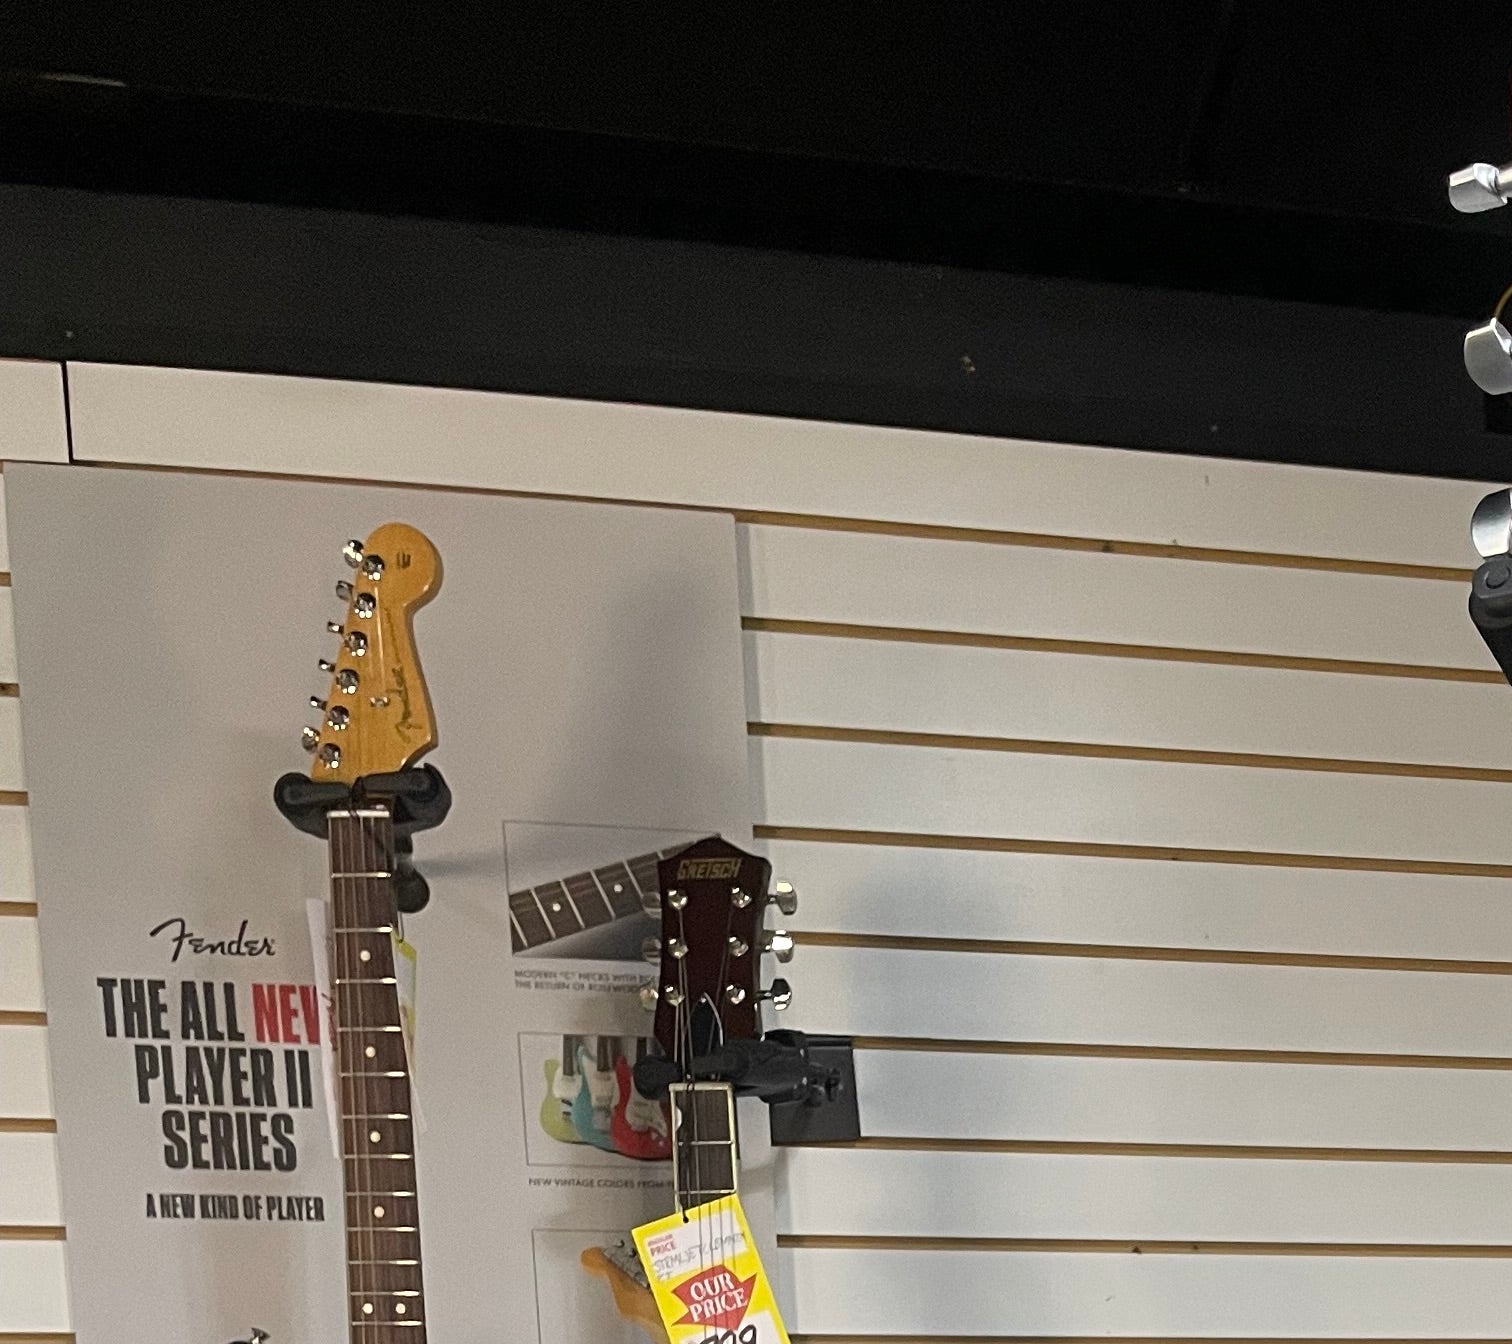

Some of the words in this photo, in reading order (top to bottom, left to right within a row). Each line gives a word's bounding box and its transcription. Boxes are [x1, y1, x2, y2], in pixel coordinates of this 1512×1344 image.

[677, 858, 742, 880] GRETSCH
[150, 917, 276, 962] Fender
[97, 977, 170, 1040] THE
[181, 980, 245, 1042] ALL
[134, 1044, 278, 1108] PLAYER
[284, 1049, 313, 1109] II
[162, 1110, 298, 1173] SERIES
[146, 1193, 157, 1219] A
[159, 1193, 195, 1219] NEW
[199, 1194, 240, 1220] KIND
[243, 1195, 264, 1221] OF
[266, 1195, 326, 1222] PLAYER
[688, 1287, 749, 1324] PRICE
[689, 1271, 736, 1302] OUR
